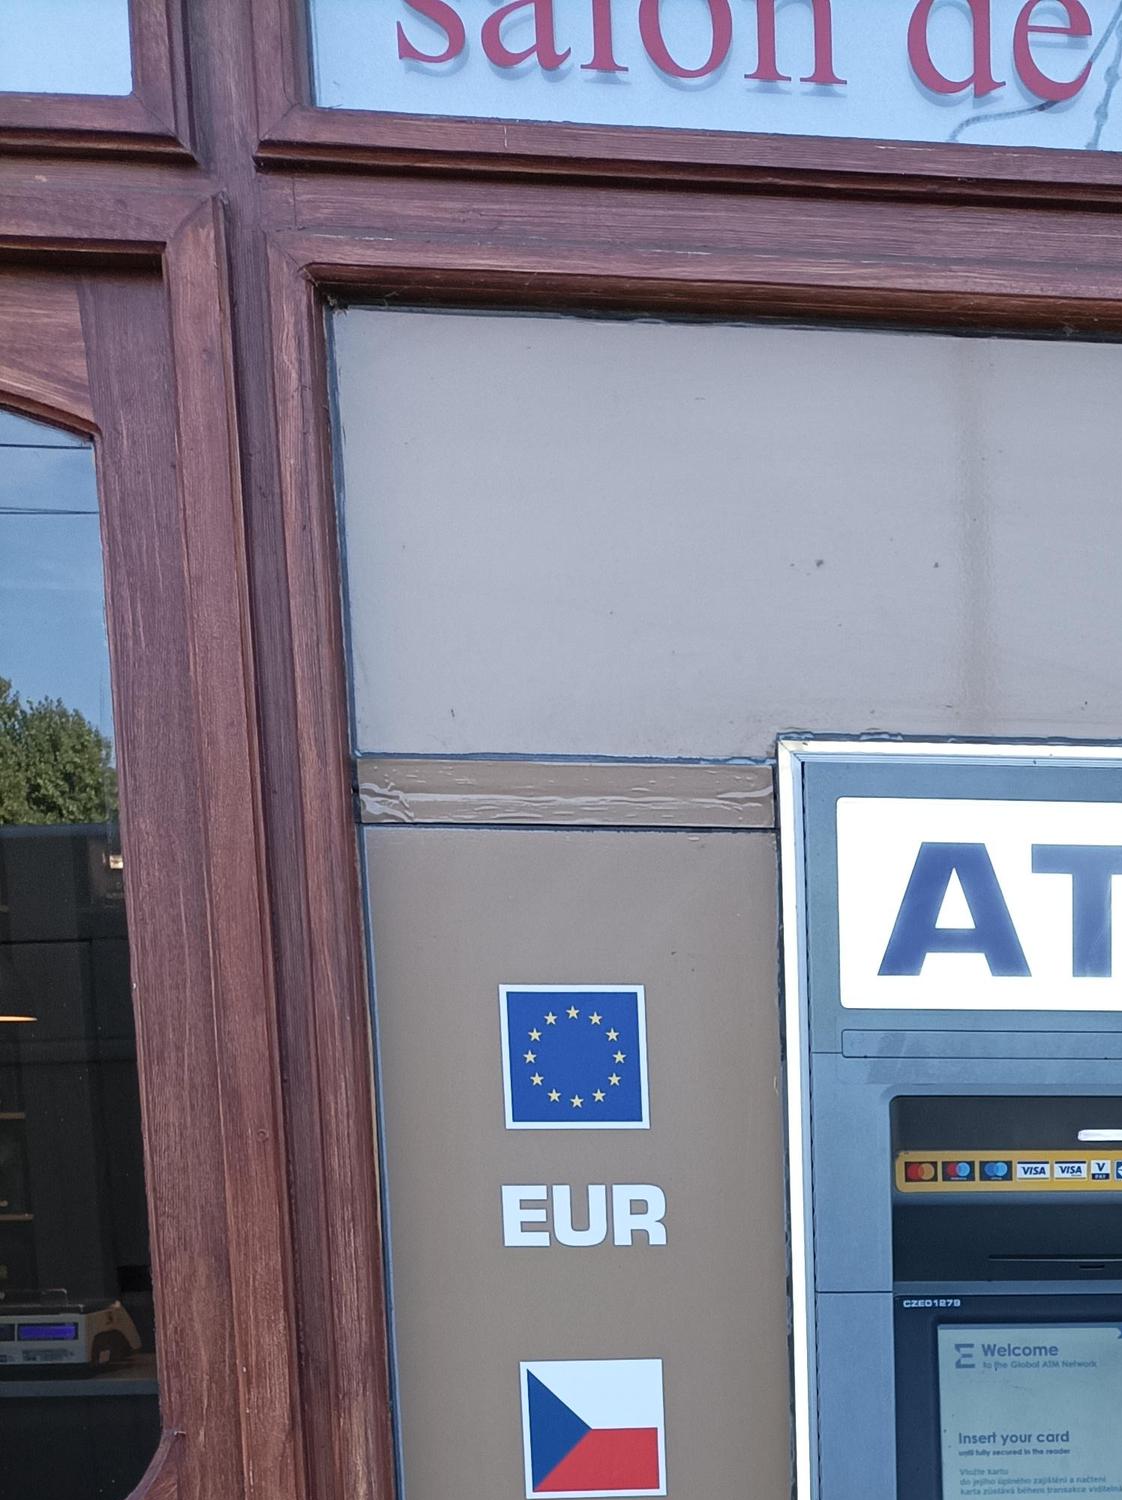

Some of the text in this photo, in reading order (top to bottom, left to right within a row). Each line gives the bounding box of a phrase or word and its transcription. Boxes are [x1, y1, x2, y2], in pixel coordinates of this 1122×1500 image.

[906, 0, 1093, 102] de
[1022, 1166, 1046, 1175] VISA
[1059, 1165, 1082, 1174] VISA
[502, 1184, 667, 1247] EUR
[982, 1343, 1058, 1357] Welcome
[1010, 1360, 1040, 1368] Global
[1042, 1360, 1060, 1368] ATM
[1061, 1360, 1097, 1368] Network
[958, 1431, 1070, 1446] Insert your card
